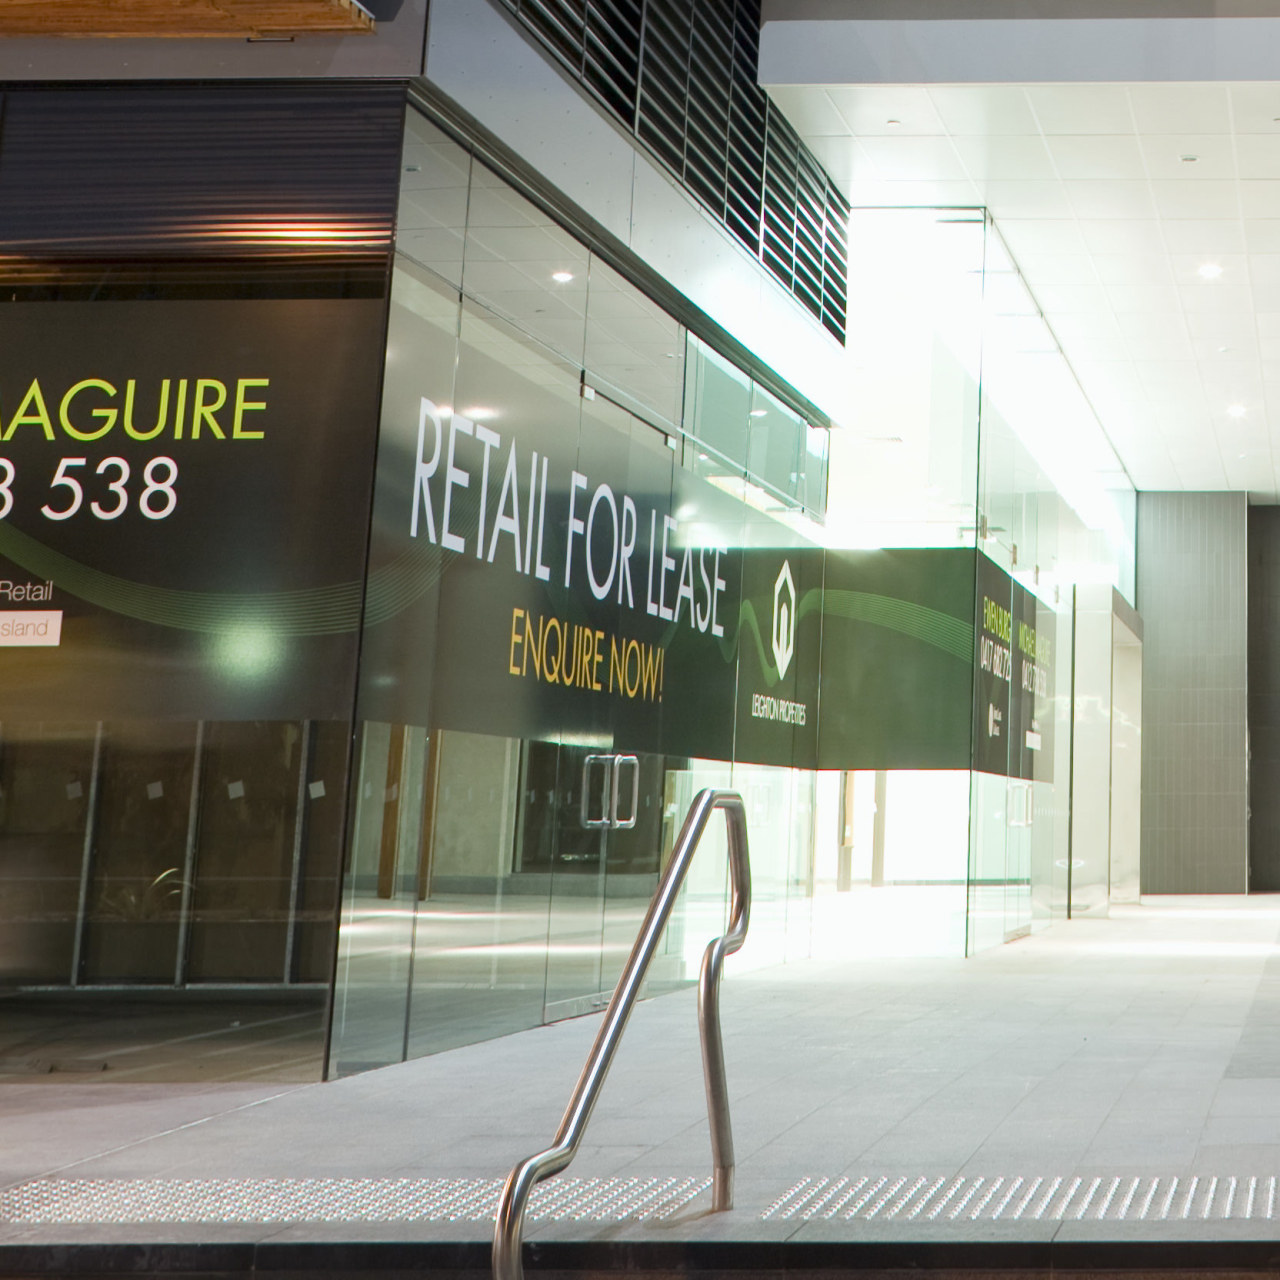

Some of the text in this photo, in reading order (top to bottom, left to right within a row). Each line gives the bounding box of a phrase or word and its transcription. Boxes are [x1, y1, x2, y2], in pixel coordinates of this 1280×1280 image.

[0, 378, 270, 441] AGUIRE
[40, 456, 179, 521] 538
[410, 396, 728, 637] RETAIL FOR LEASE
[0, 580, 53, 601] Retail
[509, 608, 665, 703] ENQUIRE NOW!
[752, 693, 807, 726] LEIGHTON PROPERTIES
